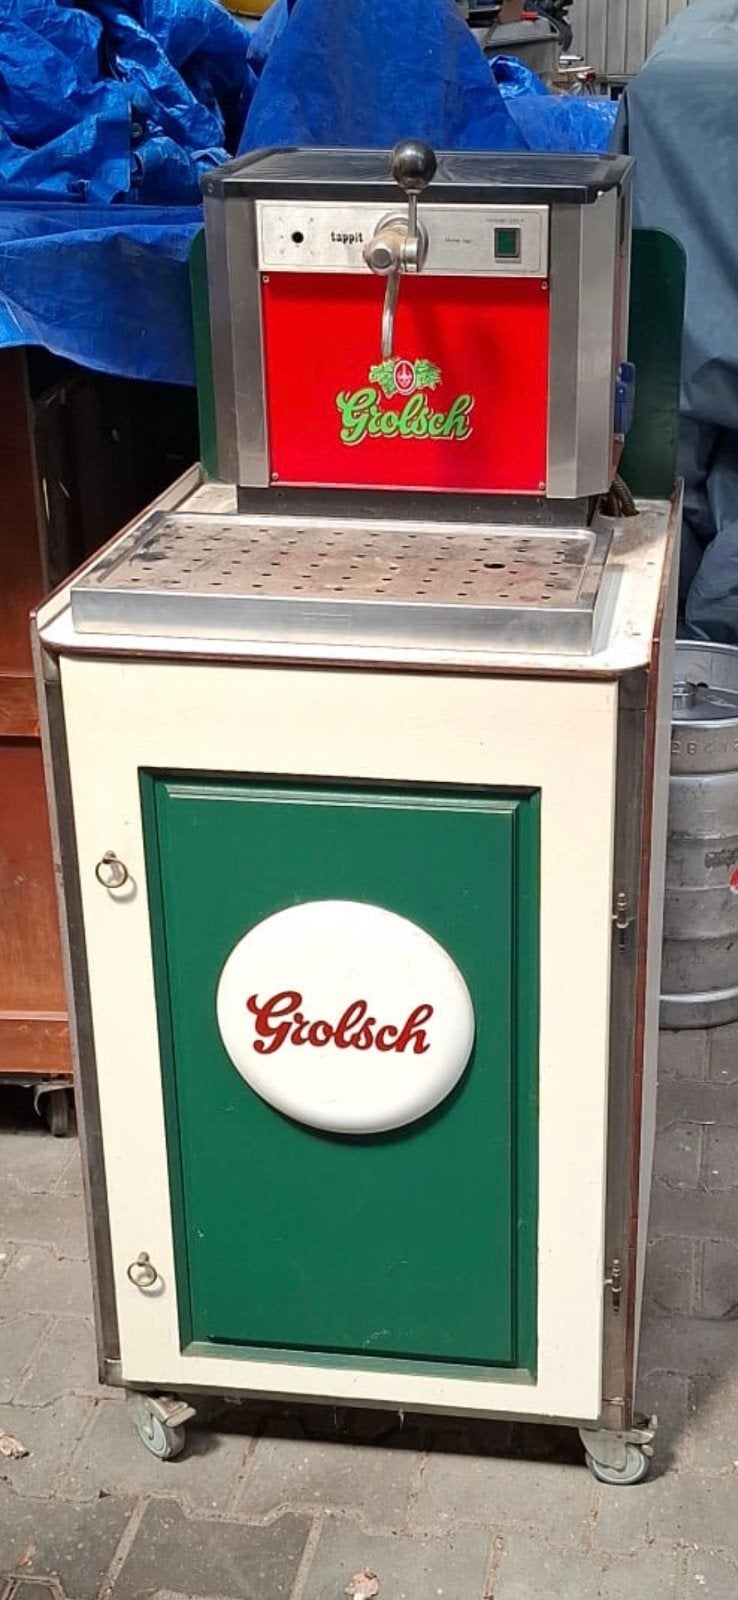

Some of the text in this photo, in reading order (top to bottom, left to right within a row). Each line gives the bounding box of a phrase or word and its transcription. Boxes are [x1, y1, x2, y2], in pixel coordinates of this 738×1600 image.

[331, 231, 363, 245] tappit
[336, 387, 475, 445] Grolsch
[246, 990, 434, 1055] Grolsch
